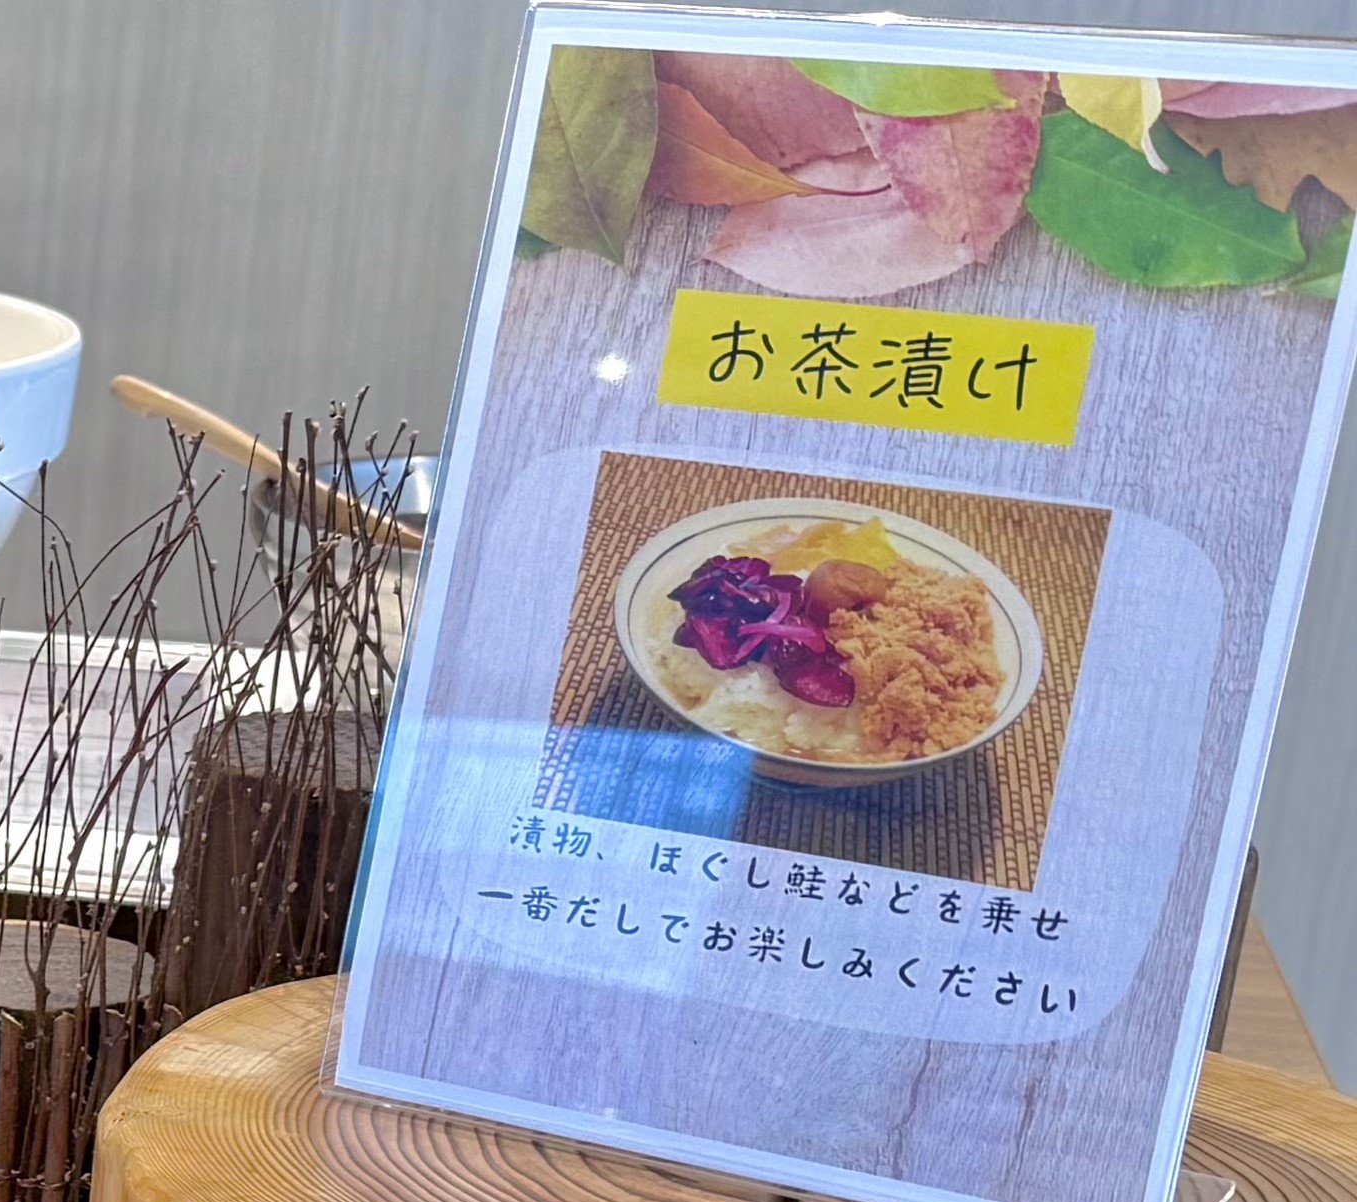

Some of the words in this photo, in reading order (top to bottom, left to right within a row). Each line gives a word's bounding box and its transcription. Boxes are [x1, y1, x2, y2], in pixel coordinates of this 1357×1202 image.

[708, 319, 1038, 411] お茶漬け
[508, 814, 1069, 942] 漬物、ほぐし鮭などを乗せ
[477, 885, 1078, 1015] 一番だしでお楽しみください
